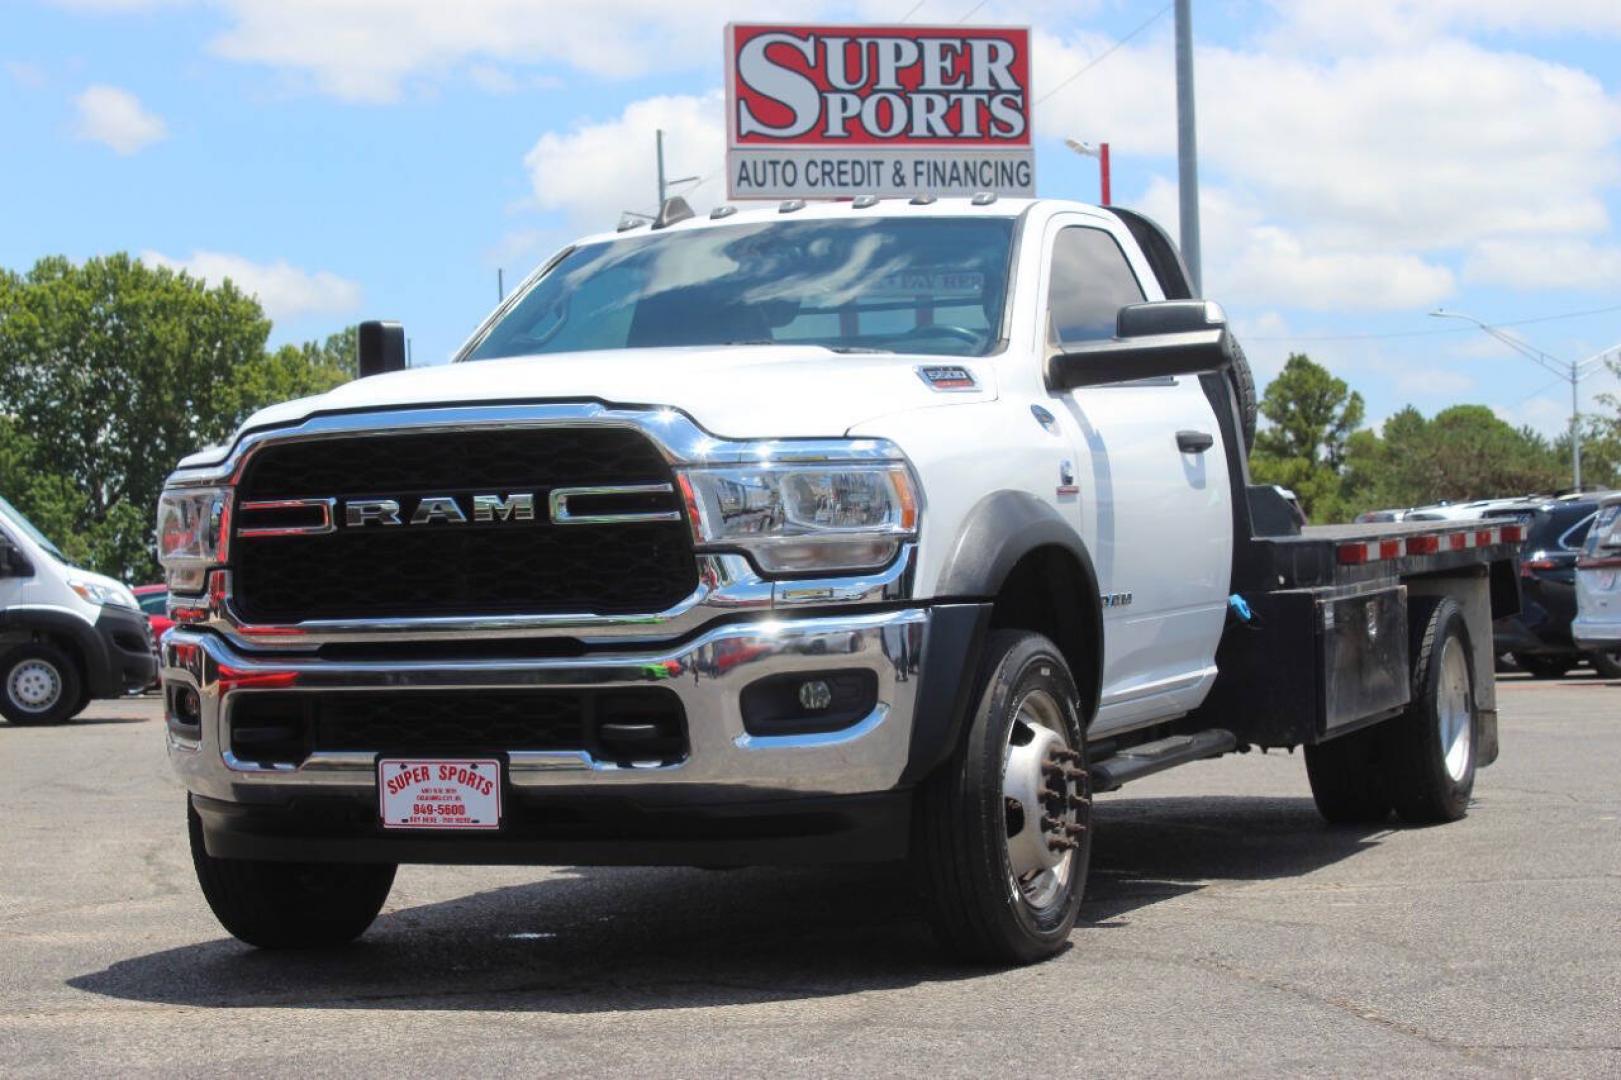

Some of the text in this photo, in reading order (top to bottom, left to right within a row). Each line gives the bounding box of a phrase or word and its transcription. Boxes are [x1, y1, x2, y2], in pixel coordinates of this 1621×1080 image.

[738, 32, 1022, 138] SUPER
[737, 160, 1031, 188] AUTO CREDIT & FINANCING
[346, 493, 534, 528] RAM
[387, 765, 494, 796] SUPER SPORTS
